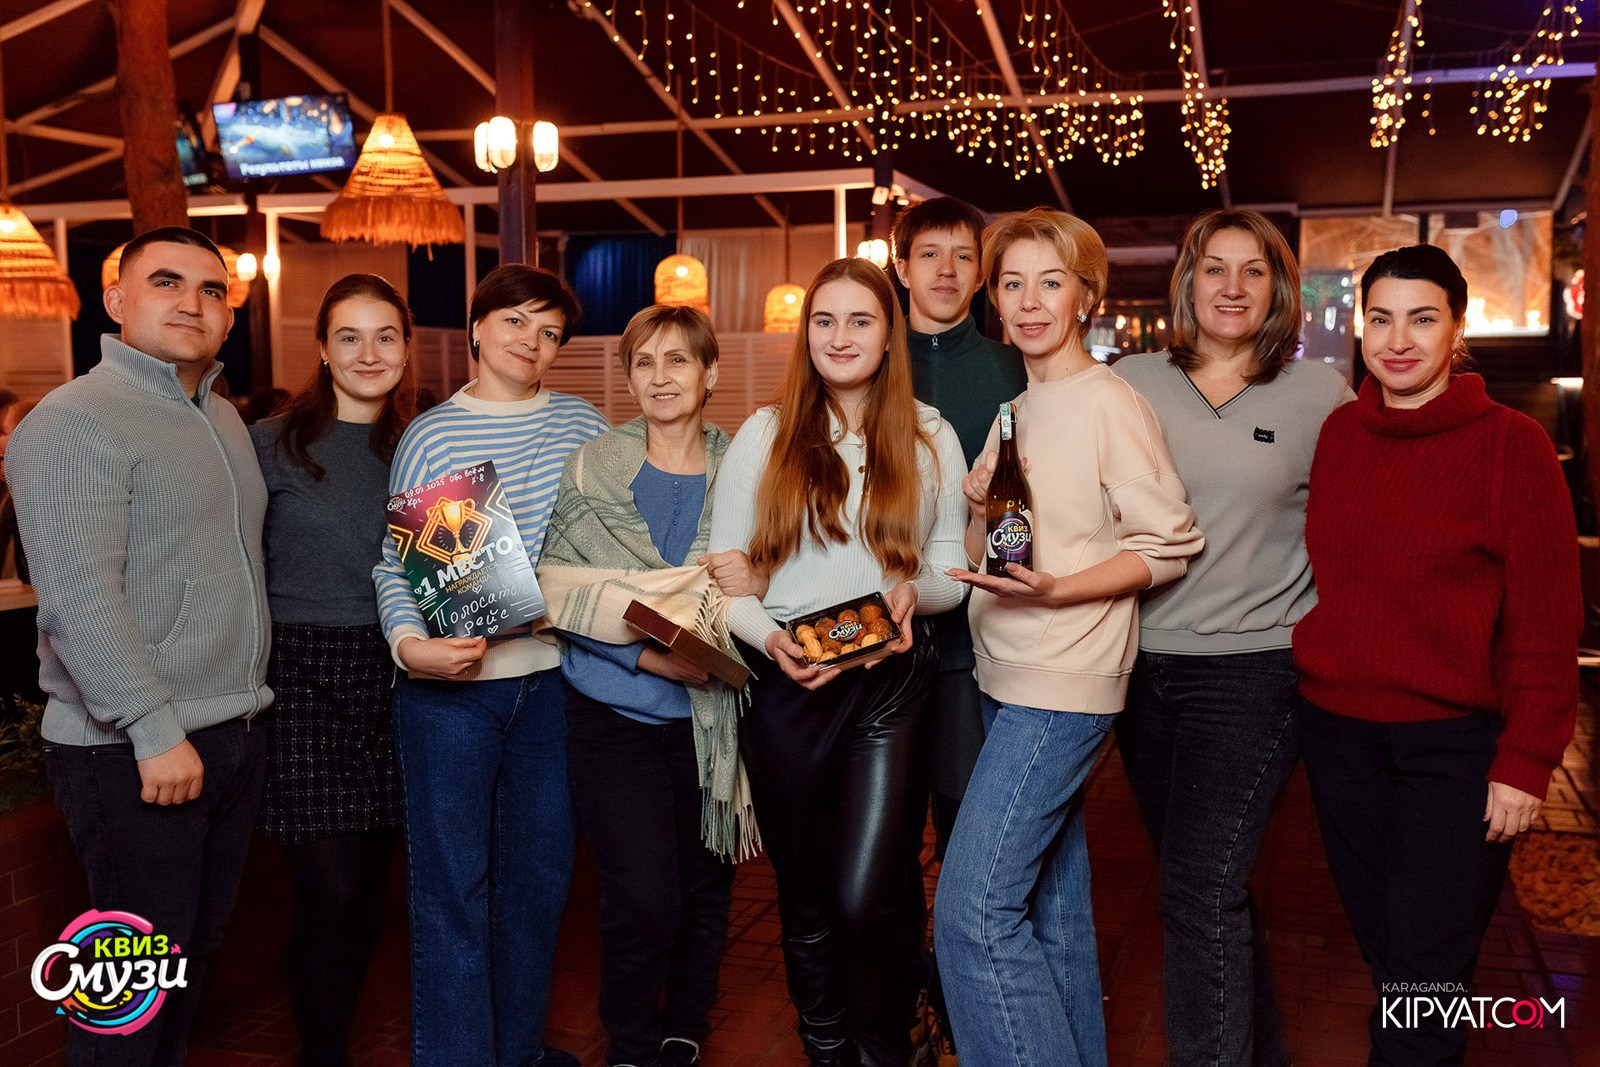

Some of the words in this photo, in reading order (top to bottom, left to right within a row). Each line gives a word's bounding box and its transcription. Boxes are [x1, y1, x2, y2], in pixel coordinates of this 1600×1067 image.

[992, 528, 1031, 546] Смузи
[1007, 525, 1028, 533] КВИЗ
[420, 577, 436, 597] 1
[436, 535, 513, 589] МЕСТО
[445, 561, 498, 593] НАГРАЖДАЕТСЯ
[456, 573, 492, 595] КОМАНДА
